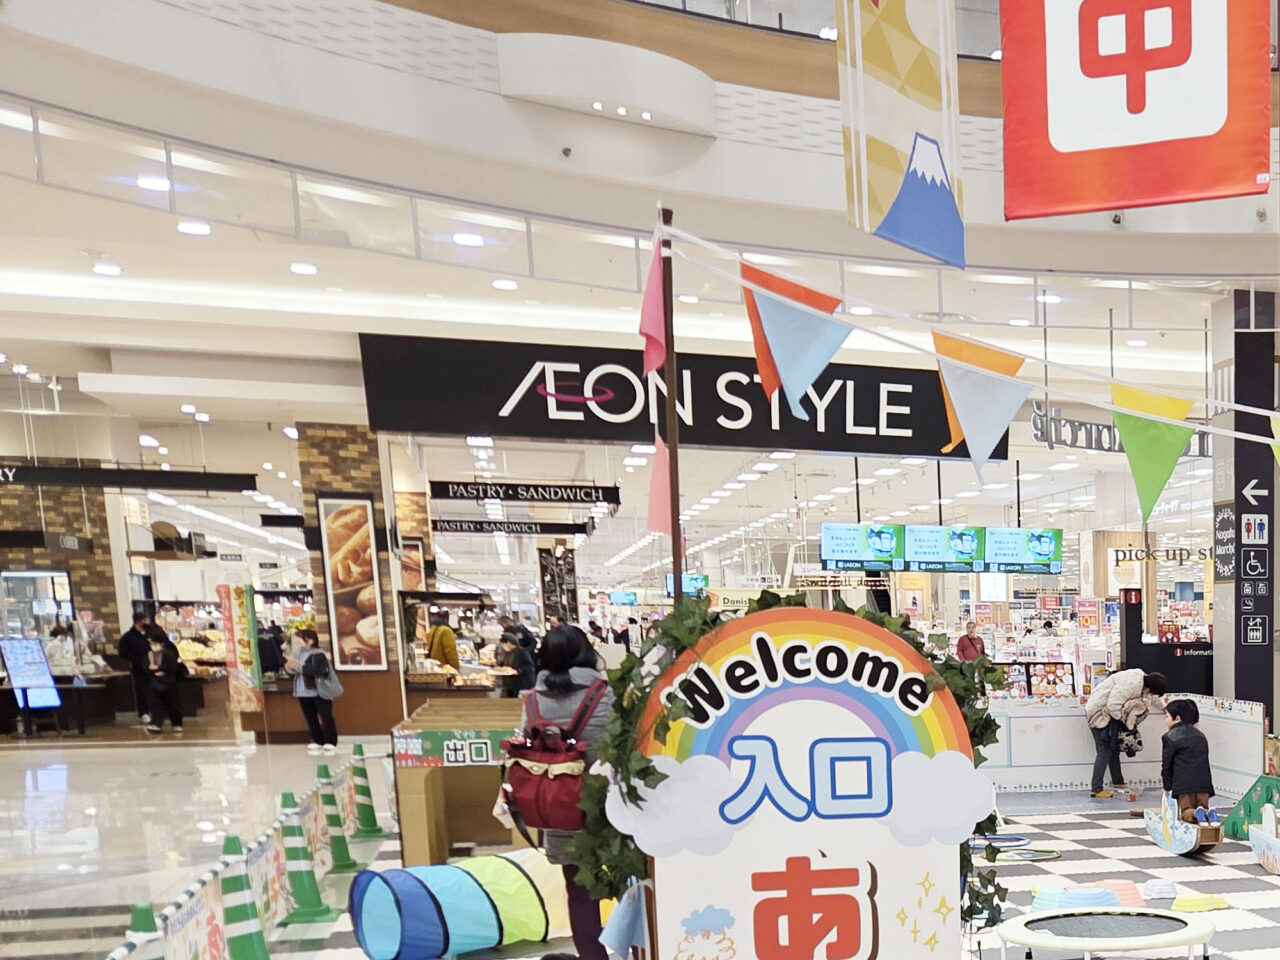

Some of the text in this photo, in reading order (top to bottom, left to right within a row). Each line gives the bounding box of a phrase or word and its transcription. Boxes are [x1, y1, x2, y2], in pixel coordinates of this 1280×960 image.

[1078, 0, 1193, 115] 中
[448, 484, 604, 501] PASTRY SANDWICH
[436, 521, 541, 533] PASTRY SANDWICH
[1114, 543, 1214, 567] pick up st
[664, 637, 934, 724] Welcome
[445, 741, 490, 764] 出口
[719, 735, 893, 824] 入口
